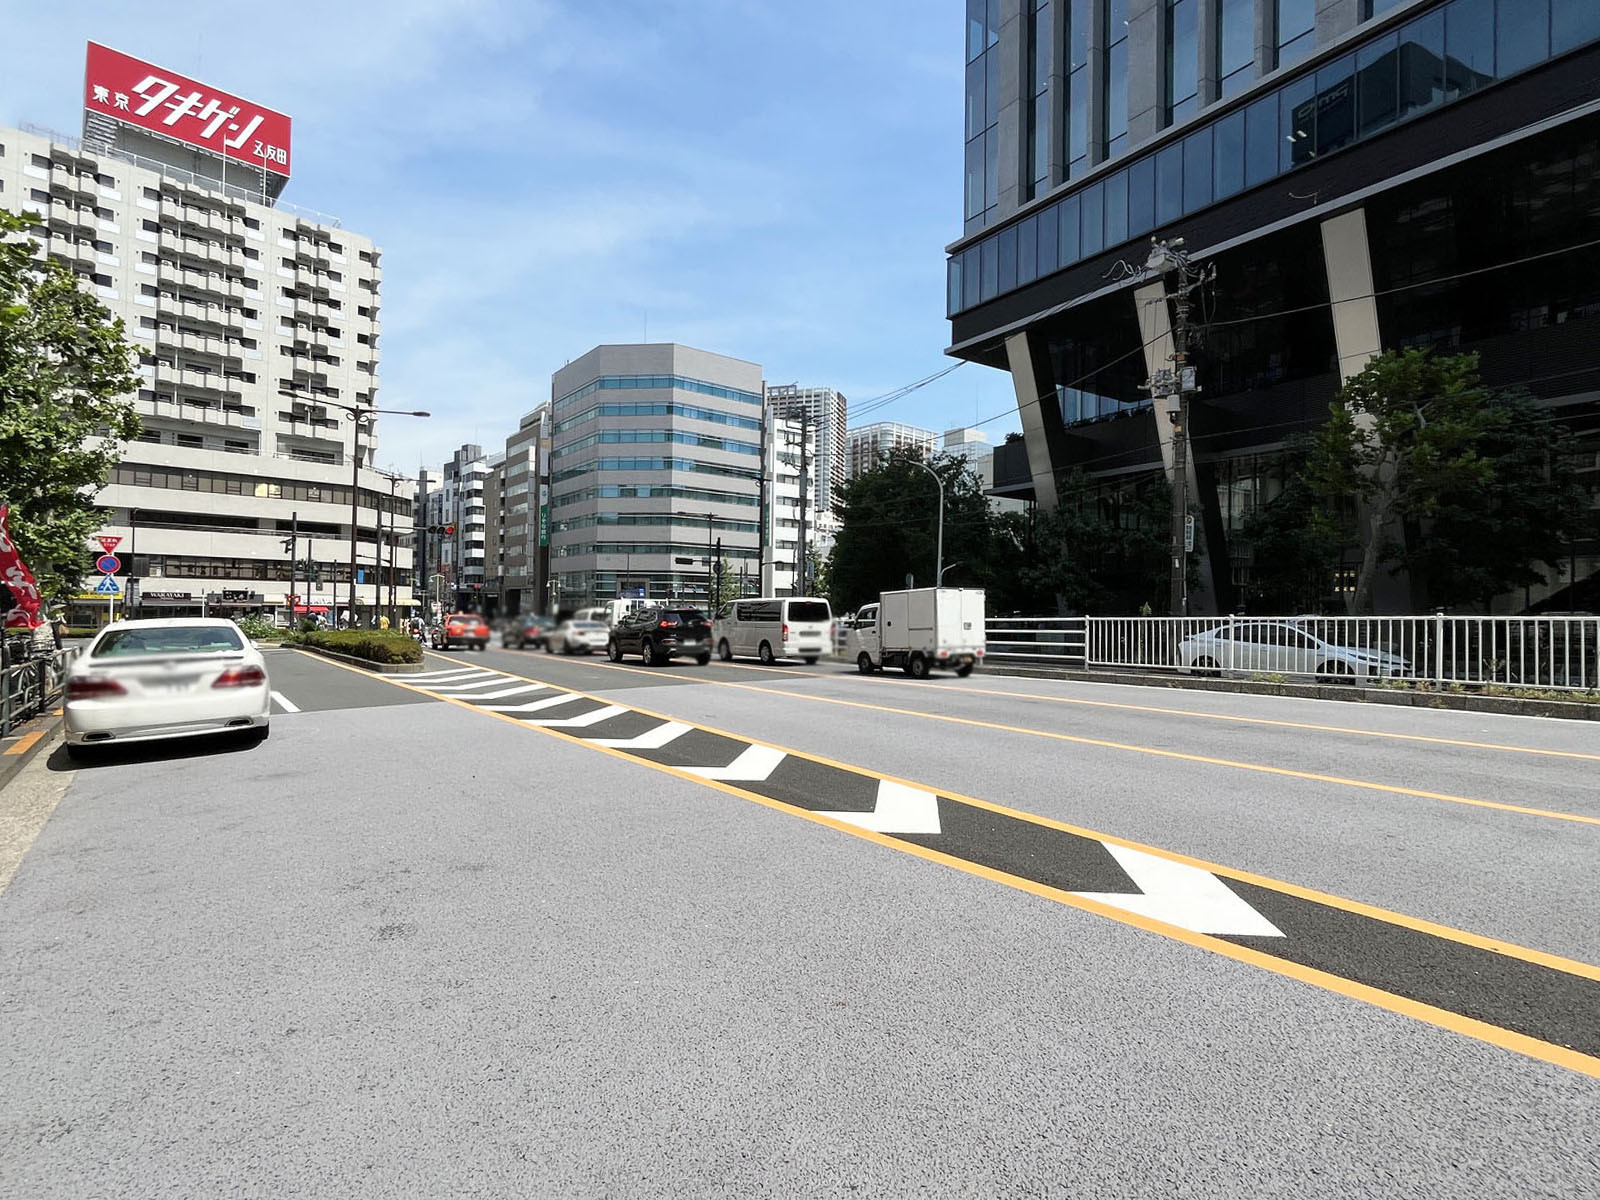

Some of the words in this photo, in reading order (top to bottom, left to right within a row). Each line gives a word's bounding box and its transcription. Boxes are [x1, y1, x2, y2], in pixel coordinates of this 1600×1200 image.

[92, 83, 130, 112] 東京
[131, 75, 265, 150] タキゲン
[252, 140, 288, 166] 五反田
